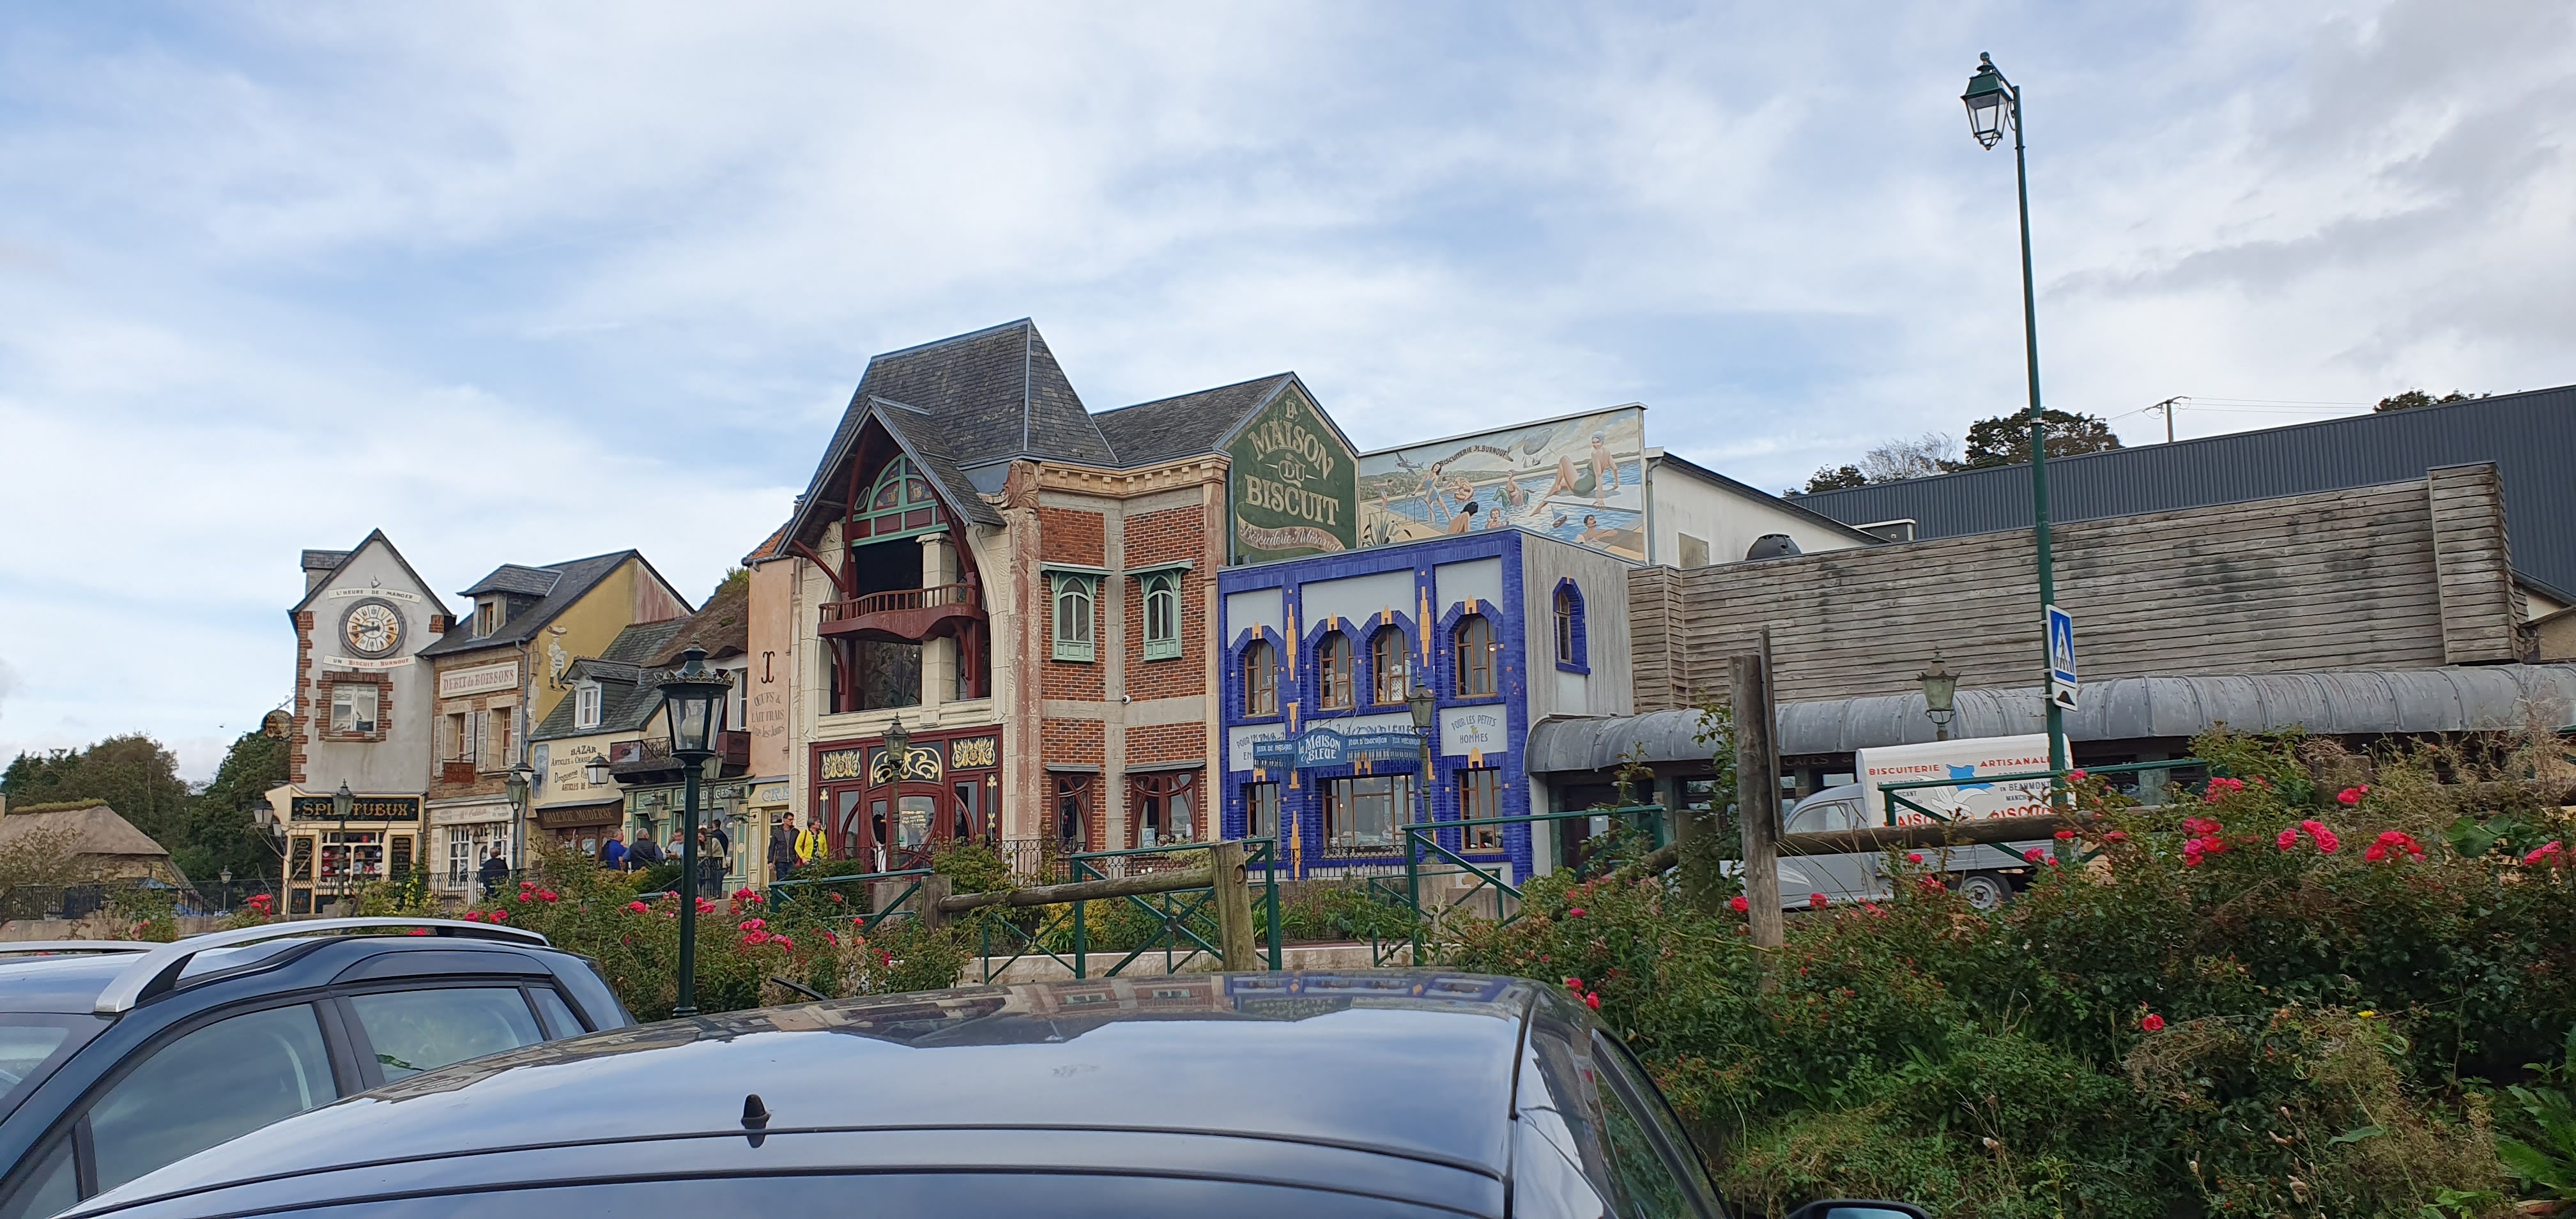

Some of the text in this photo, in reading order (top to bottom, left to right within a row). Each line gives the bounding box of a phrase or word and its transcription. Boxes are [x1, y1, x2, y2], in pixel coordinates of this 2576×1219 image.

[1248, 420, 1334, 480] MAISON
[1439, 447, 1472, 466] BISCUITERIE
[1482, 445, 1507, 457] BURNOUF
[1278, 452, 1306, 487] DU
[1245, 474, 1339, 526] BISCUIT
[386, 591, 413, 599] MANGER
[475, 670, 514, 686] BOISSONS
[776, 695, 781, 704] &
[751, 709, 785, 723] LAIT FRAIS
[1452, 715, 1497, 731] POUR LES PETITS
[1236, 738, 1250, 749] POUR
[1298, 735, 1340, 755] la MAISON
[1460, 733, 1488, 744] HOMMES
[571, 745, 596, 755] BAZAR
[1307, 748, 1337, 763] BLEUE
[1869, 765, 1940, 775] BISCUITERIE
[302, 803, 408, 816] SPITUEUX
[544, 808, 613, 823] GALERIE MODERNE
